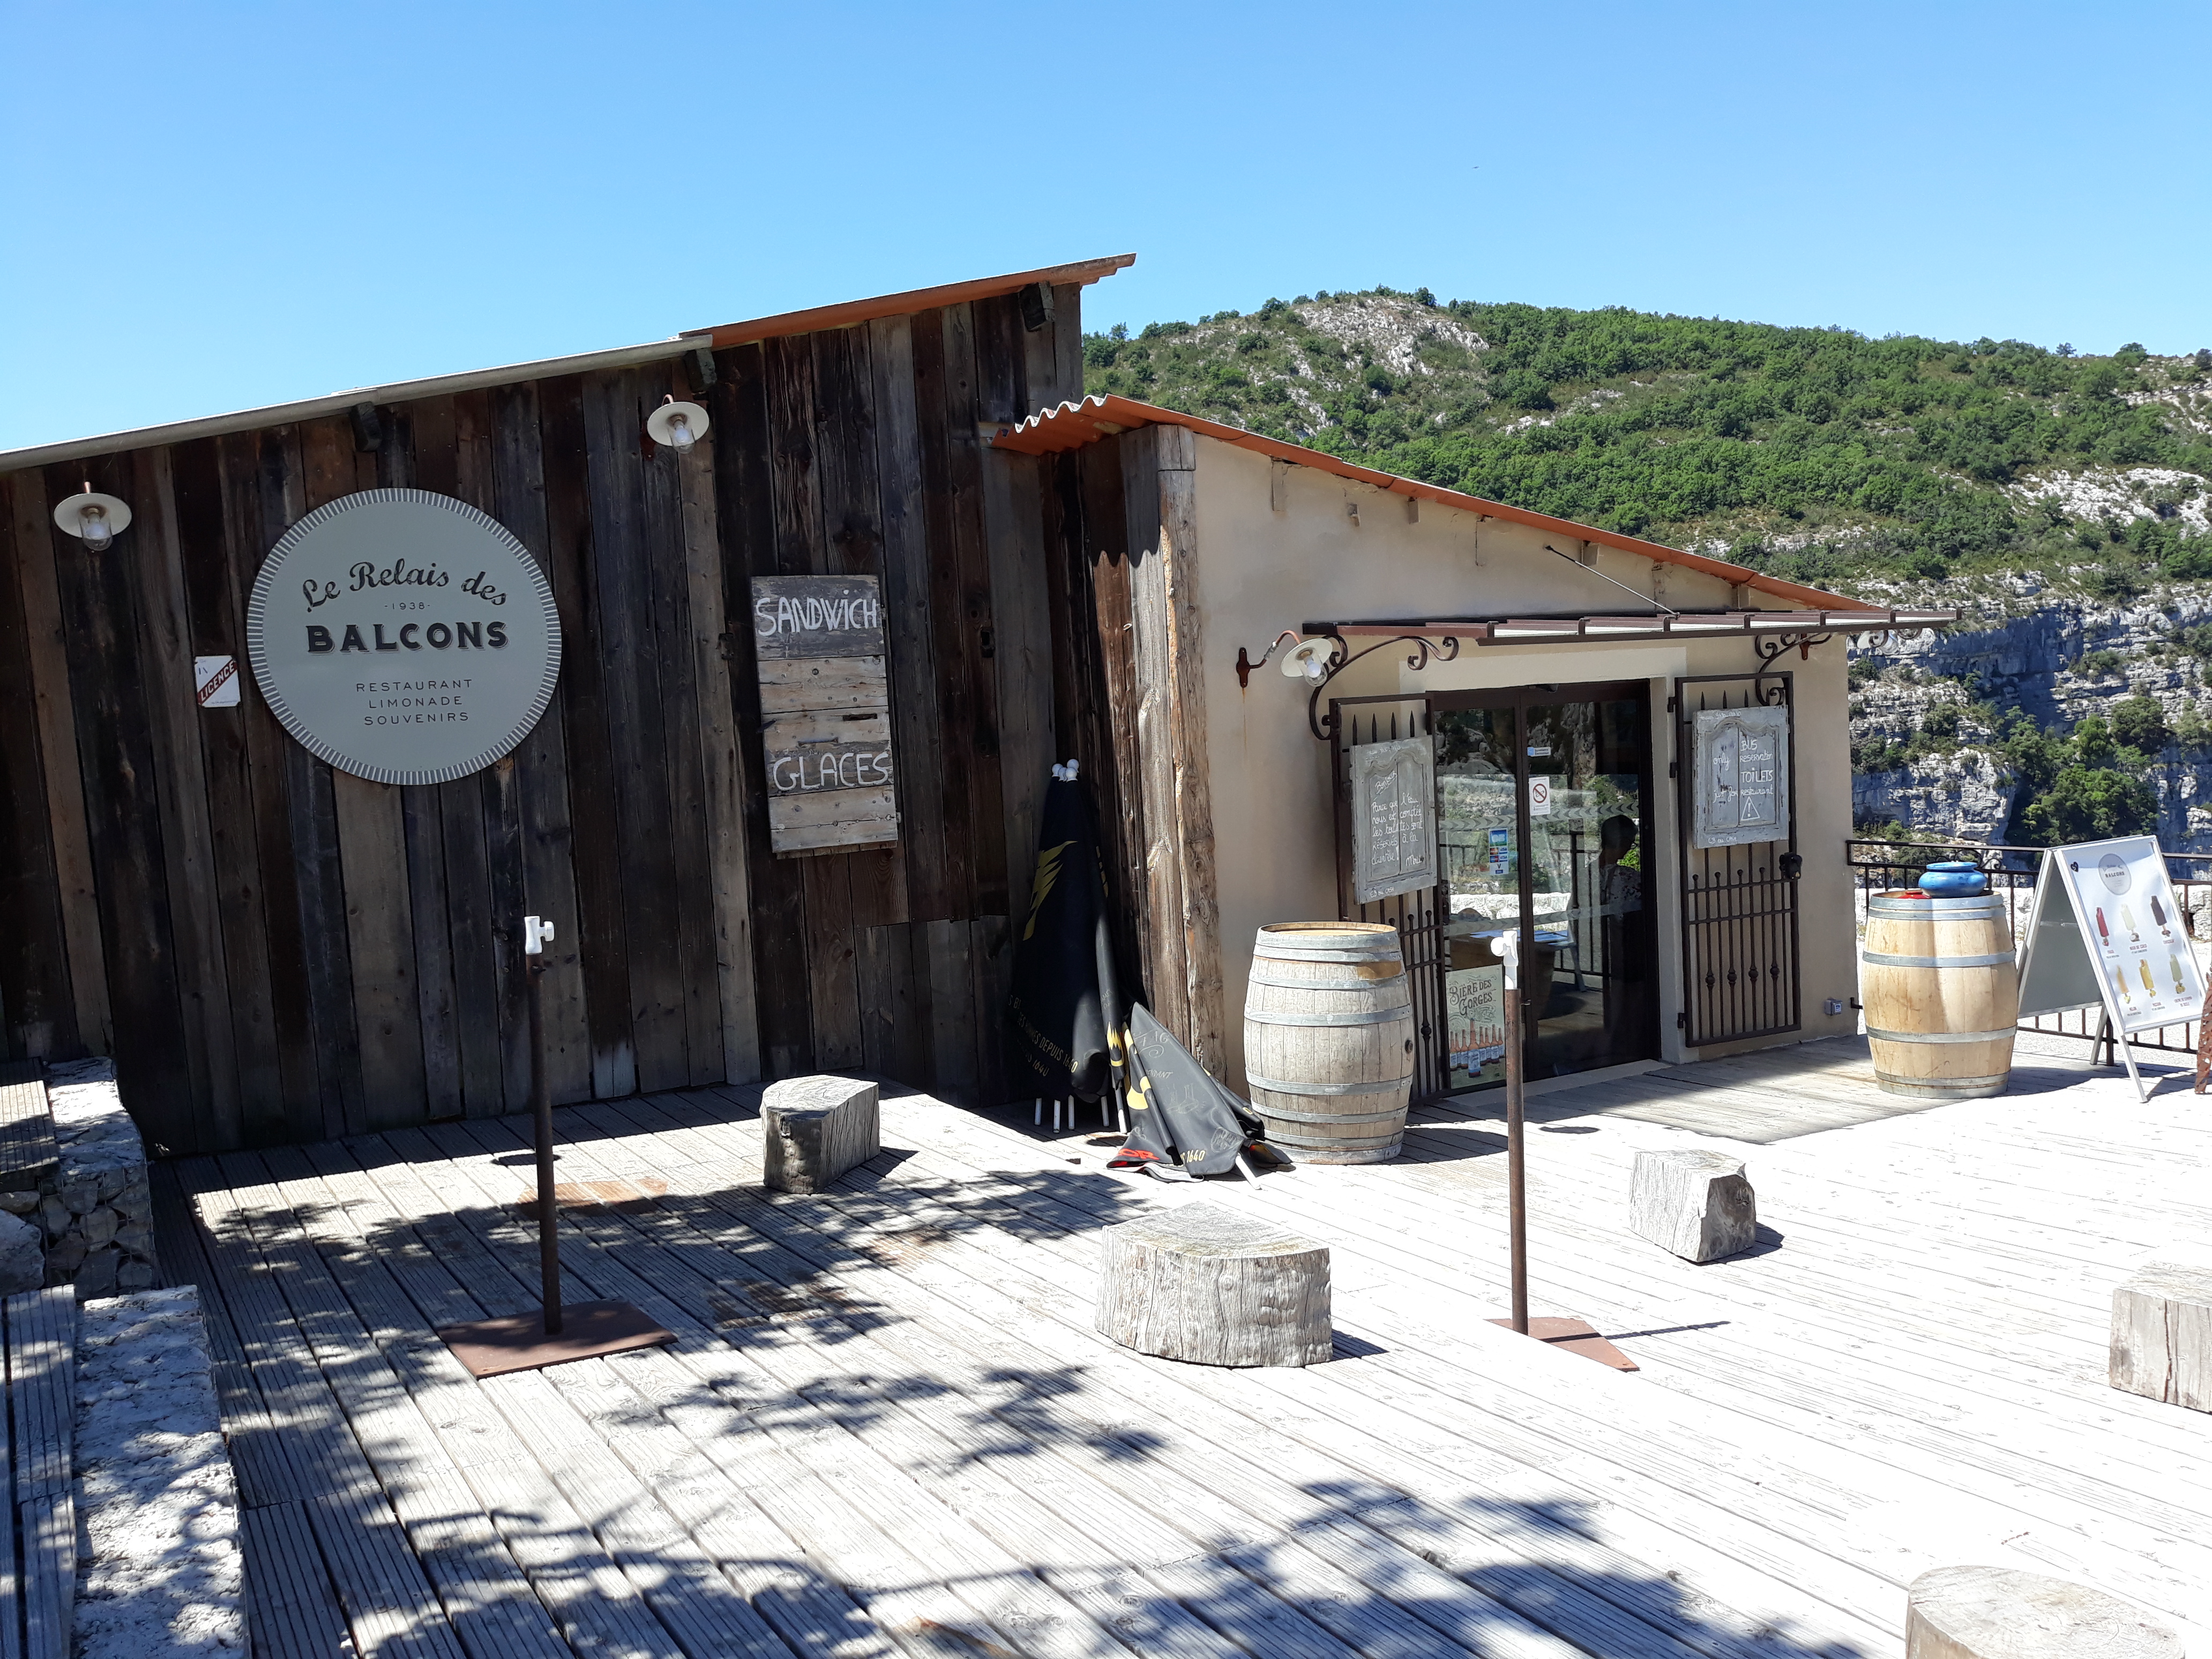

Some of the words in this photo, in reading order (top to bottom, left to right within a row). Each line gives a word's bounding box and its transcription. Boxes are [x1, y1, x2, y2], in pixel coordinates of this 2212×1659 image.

[302, 578, 341, 613] Le
[349, 558, 450, 592] Relais
[461, 571, 507, 606] des
[756, 589, 878, 637] SANDWICH
[305, 621, 510, 655] BALCONS
[200, 660, 235, 701] LICENCE
[356, 679, 473, 693] RESTAURANT
[368, 696, 464, 709] LIMONADE
[363, 712, 469, 726] SOUVENIRS
[1740, 738, 1758, 752] BUS
[772, 752, 889, 791] GLACES
[1713, 752, 1731, 772] only
[1449, 982, 1478, 1006] BIÈRE
[1479, 979, 1492, 991] DES
[1459, 992, 1494, 1017] GORGES
[1038, 1036, 1064, 1062] DEPUIS
[1063, 1053, 1079, 1074] 1640
[1186, 1149, 1207, 1163] 1640
